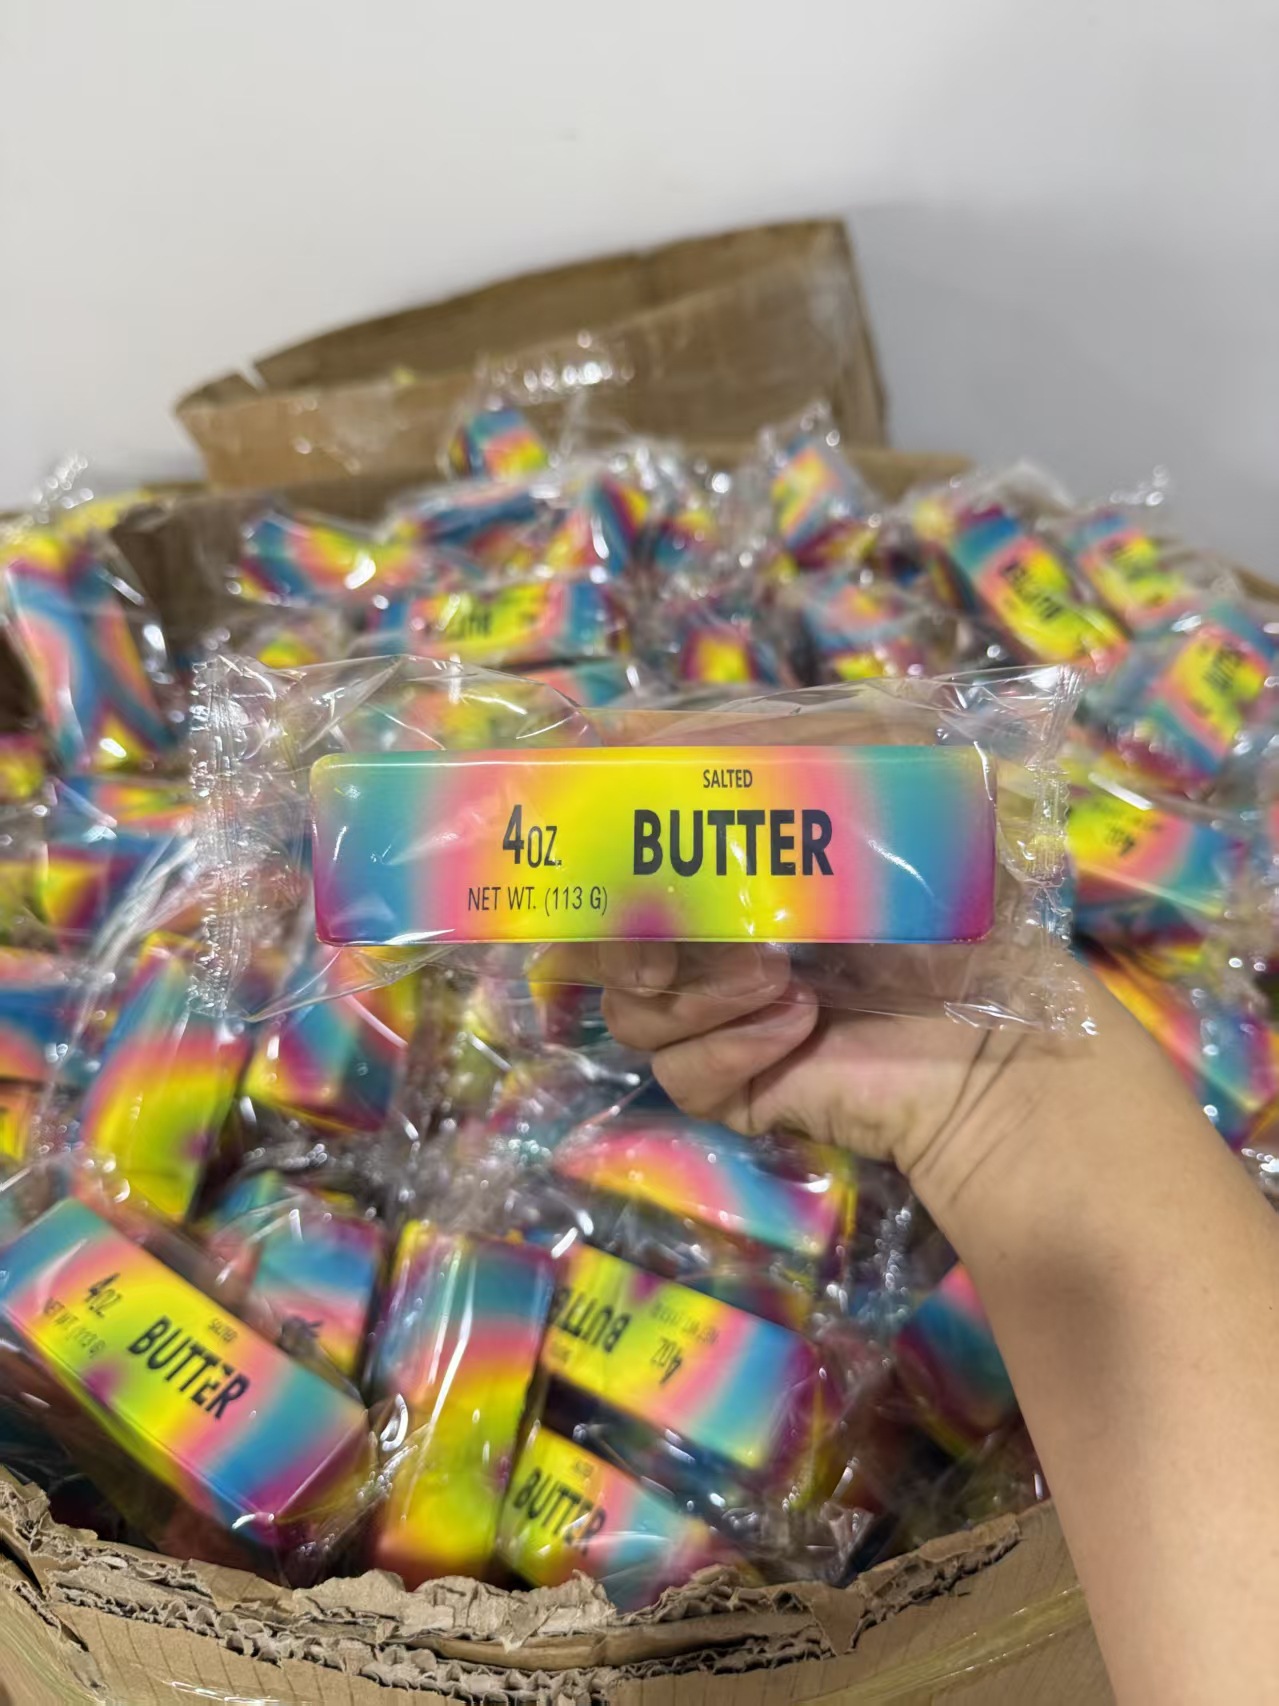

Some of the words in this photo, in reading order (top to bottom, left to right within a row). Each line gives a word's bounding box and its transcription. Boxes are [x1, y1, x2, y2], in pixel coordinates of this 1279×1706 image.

[702, 768, 753, 789] SALTED
[633, 808, 835, 878] BUTTER
[467, 886, 502, 911] NET
[507, 886, 537, 911] WT.
[544, 886, 583, 916] (113
[590, 886, 608, 916] G)
[127, 1314, 251, 1420] BUTTER
